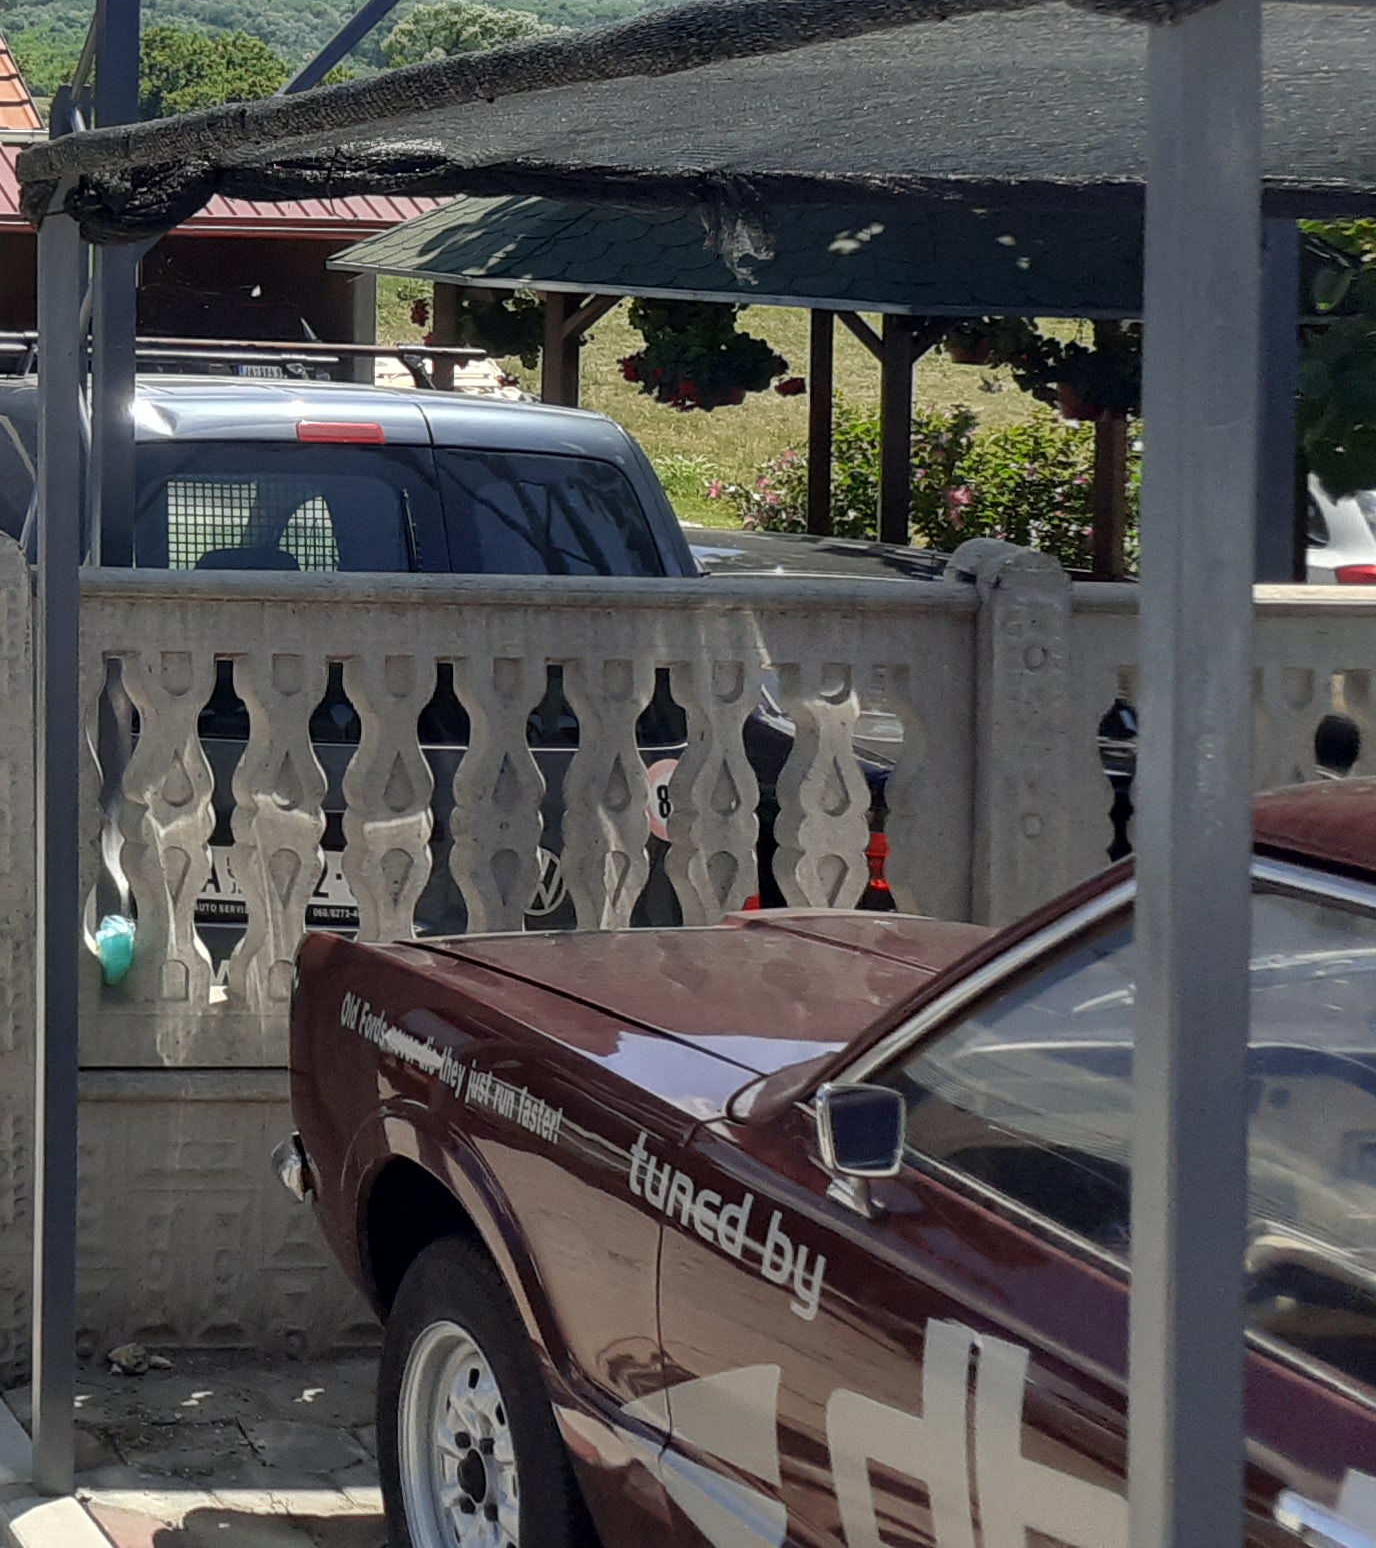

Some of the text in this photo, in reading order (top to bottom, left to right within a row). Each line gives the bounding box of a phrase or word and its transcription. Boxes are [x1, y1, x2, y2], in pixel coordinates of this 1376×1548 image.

[340, 991, 361, 1030] Old
[358, 1002, 388, 1049] Fords
[438, 1047, 466, 1098] they
[464, 1059, 493, 1103] just
[492, 1087, 516, 1119] run
[517, 1086, 563, 1145] faster!
[628, 1131, 827, 1321] tuned by
